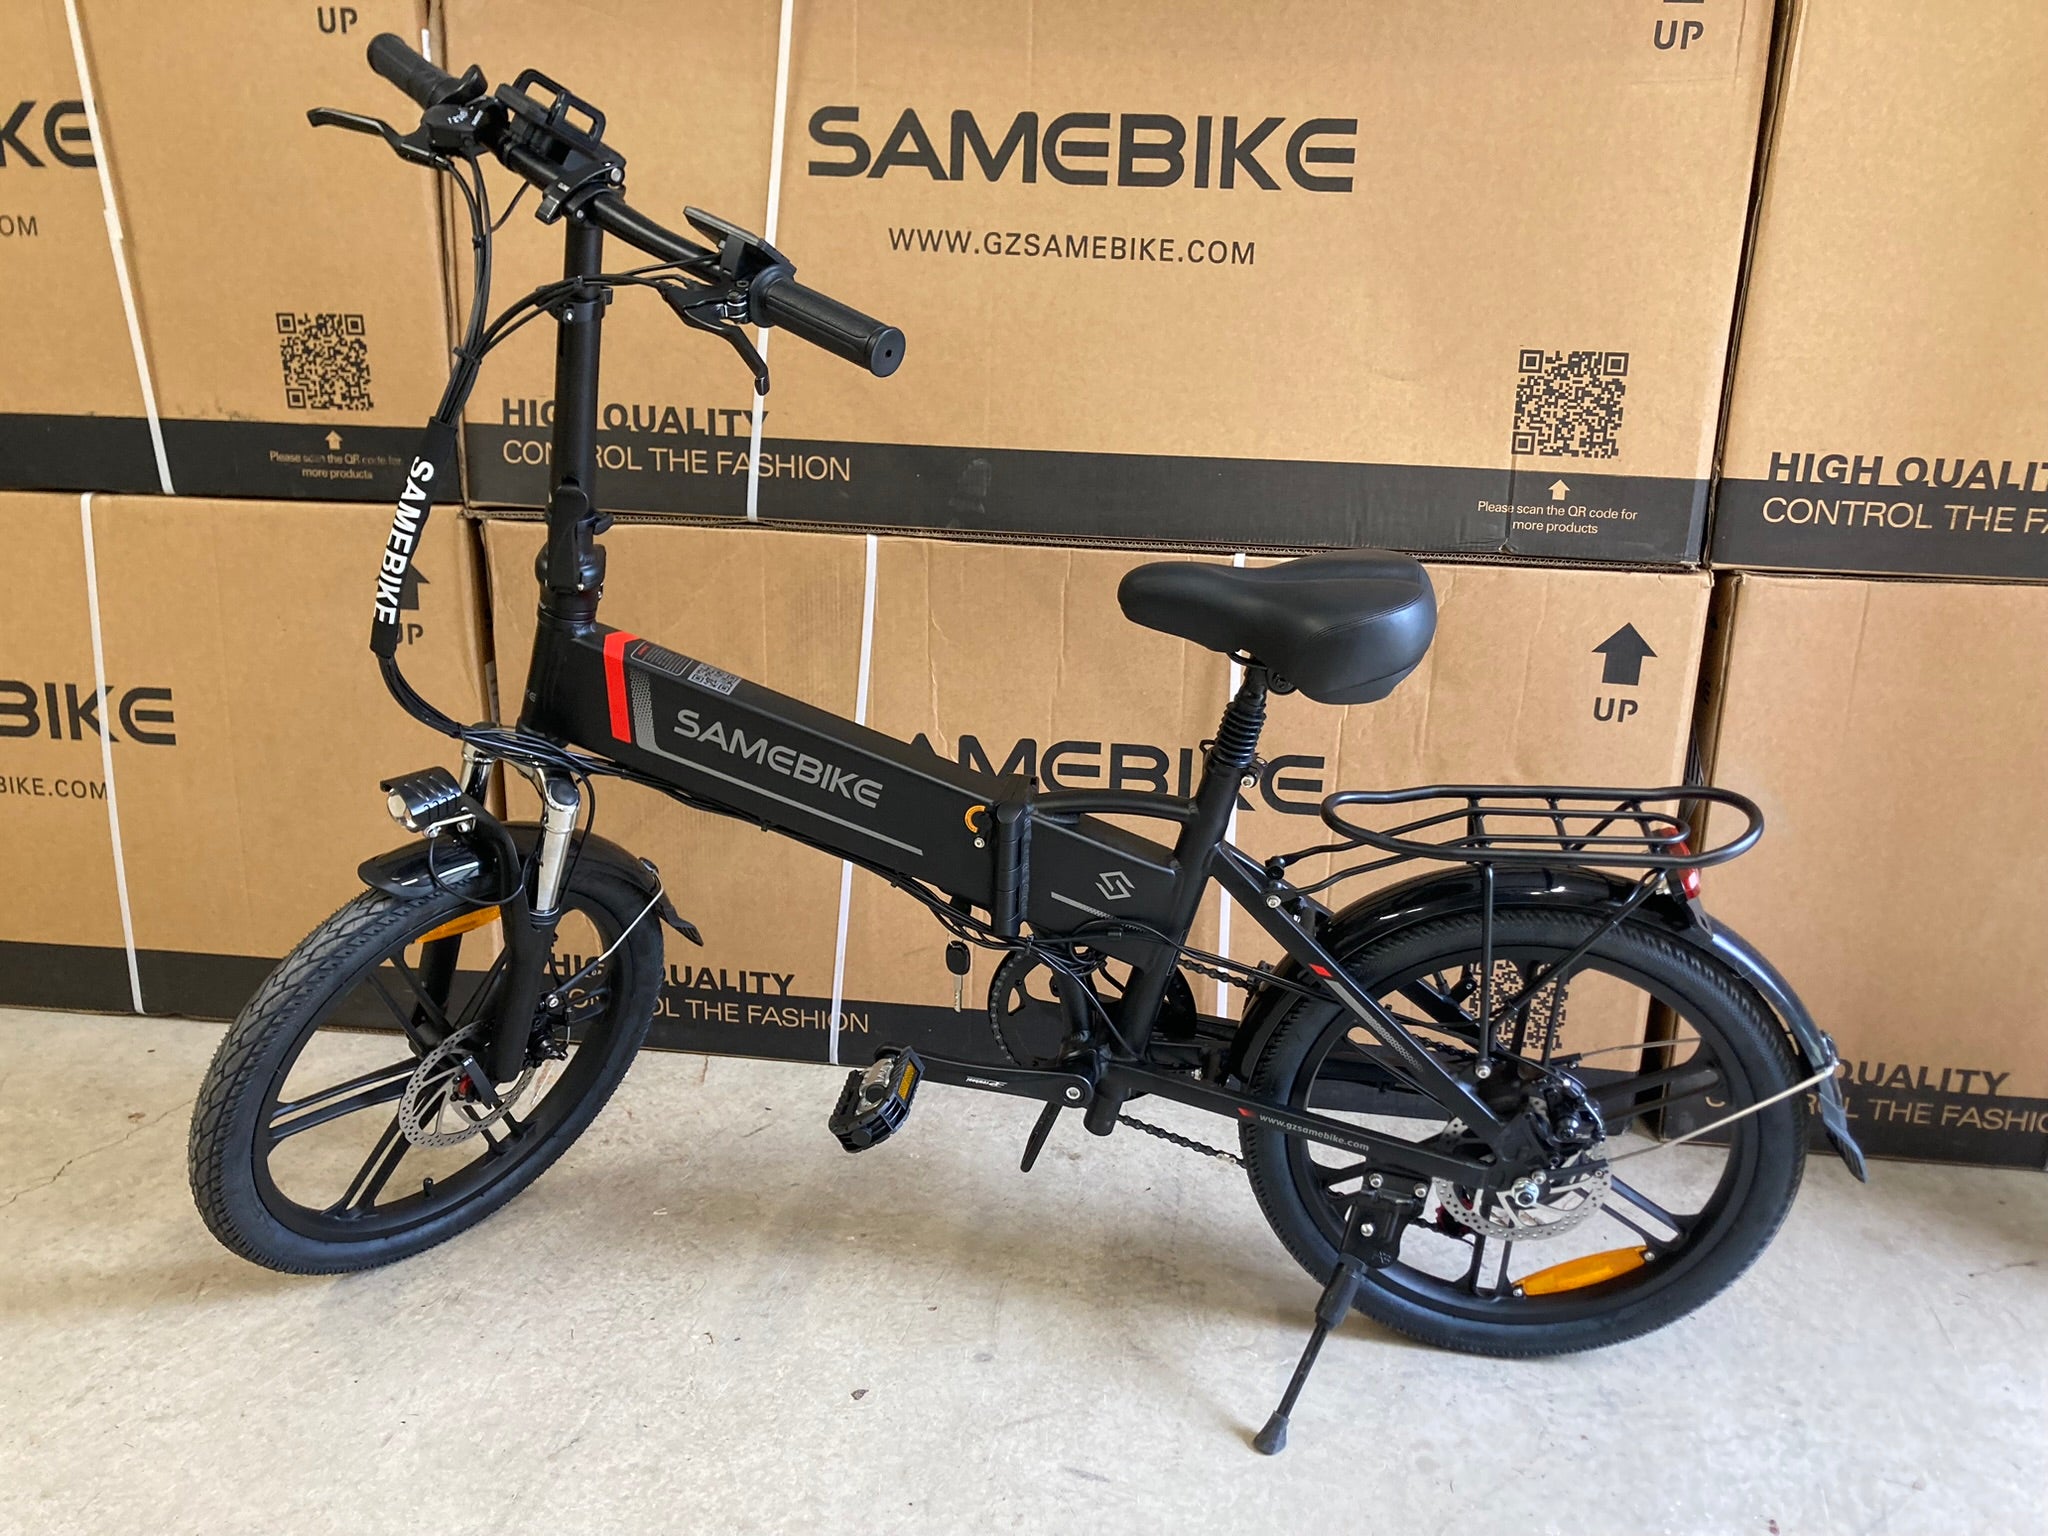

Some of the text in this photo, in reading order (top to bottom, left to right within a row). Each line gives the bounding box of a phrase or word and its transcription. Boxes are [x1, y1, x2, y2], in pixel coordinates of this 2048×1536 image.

[317, 7, 358, 34] UP
[1653, 20, 1704, 50] UP
[808, 105, 1358, 193] SAMEBIKE
[889, 227, 1255, 264] WWW.GZSAMEBIKE.COM
[302, 468, 373, 481] more products
[327, 454, 342, 465] the
[344, 454, 360, 465] QR
[648, 447, 708, 475] THE
[717, 450, 850, 481] FASHION
[1769, 452, 2048, 493] HIGH QUALI
[1477, 501, 1638, 520] Please scan the QR code for
[1762, 496, 1933, 529] CONTROL
[1944, 504, 2017, 532] THE
[374, 456, 435, 625] SAMEBIKE
[1512, 521, 1598, 535] more products
[1593, 697, 1638, 723] UP
[674, 709, 883, 808] SAMEBIKE
[663, 964, 795, 997] UALITY
[685, 999, 740, 1024] THE
[748, 1005, 868, 1034] FASHION
[1868, 1099, 1932, 1125] THE
[1260, 1115, 1369, 1151] www.gzsamebike.com
